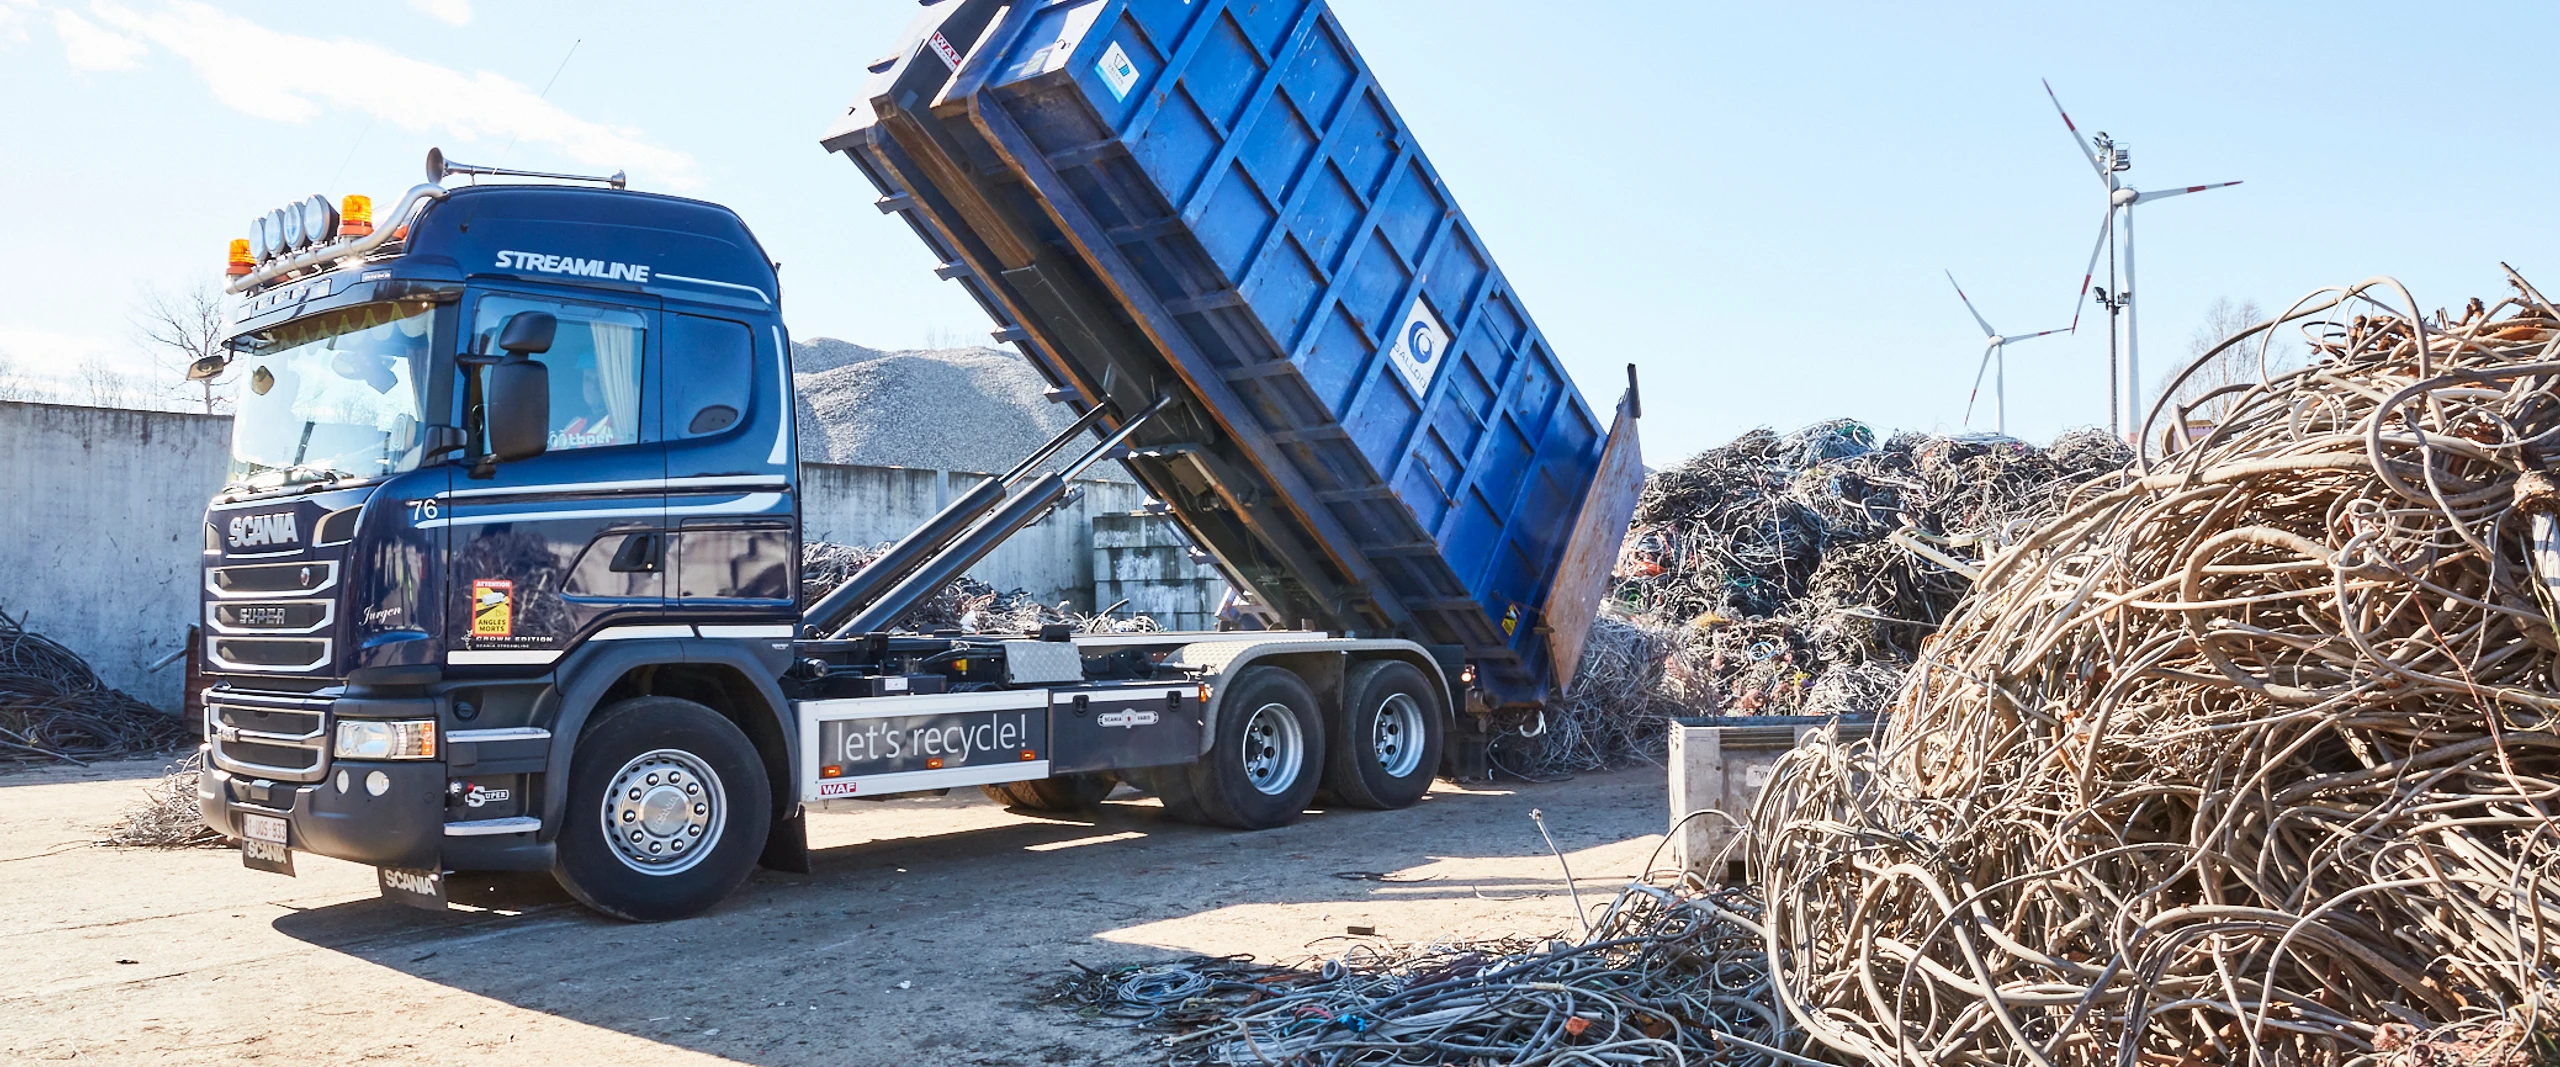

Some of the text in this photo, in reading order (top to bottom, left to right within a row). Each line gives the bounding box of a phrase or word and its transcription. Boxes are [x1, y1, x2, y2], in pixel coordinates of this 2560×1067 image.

[936, 32, 960, 64] WAF
[495, 250, 650, 283] STREAMLINE
[1393, 342, 1427, 388] GALLOO
[410, 499, 438, 520] 76
[228, 511, 299, 548] SCANIA
[239, 607, 286, 625] SUPER
[913, 712, 1026, 763] recycle!
[821, 783, 857, 795] WAF
[247, 841, 288, 864] SCANIA
[384, 869, 437, 897] SCANIA
